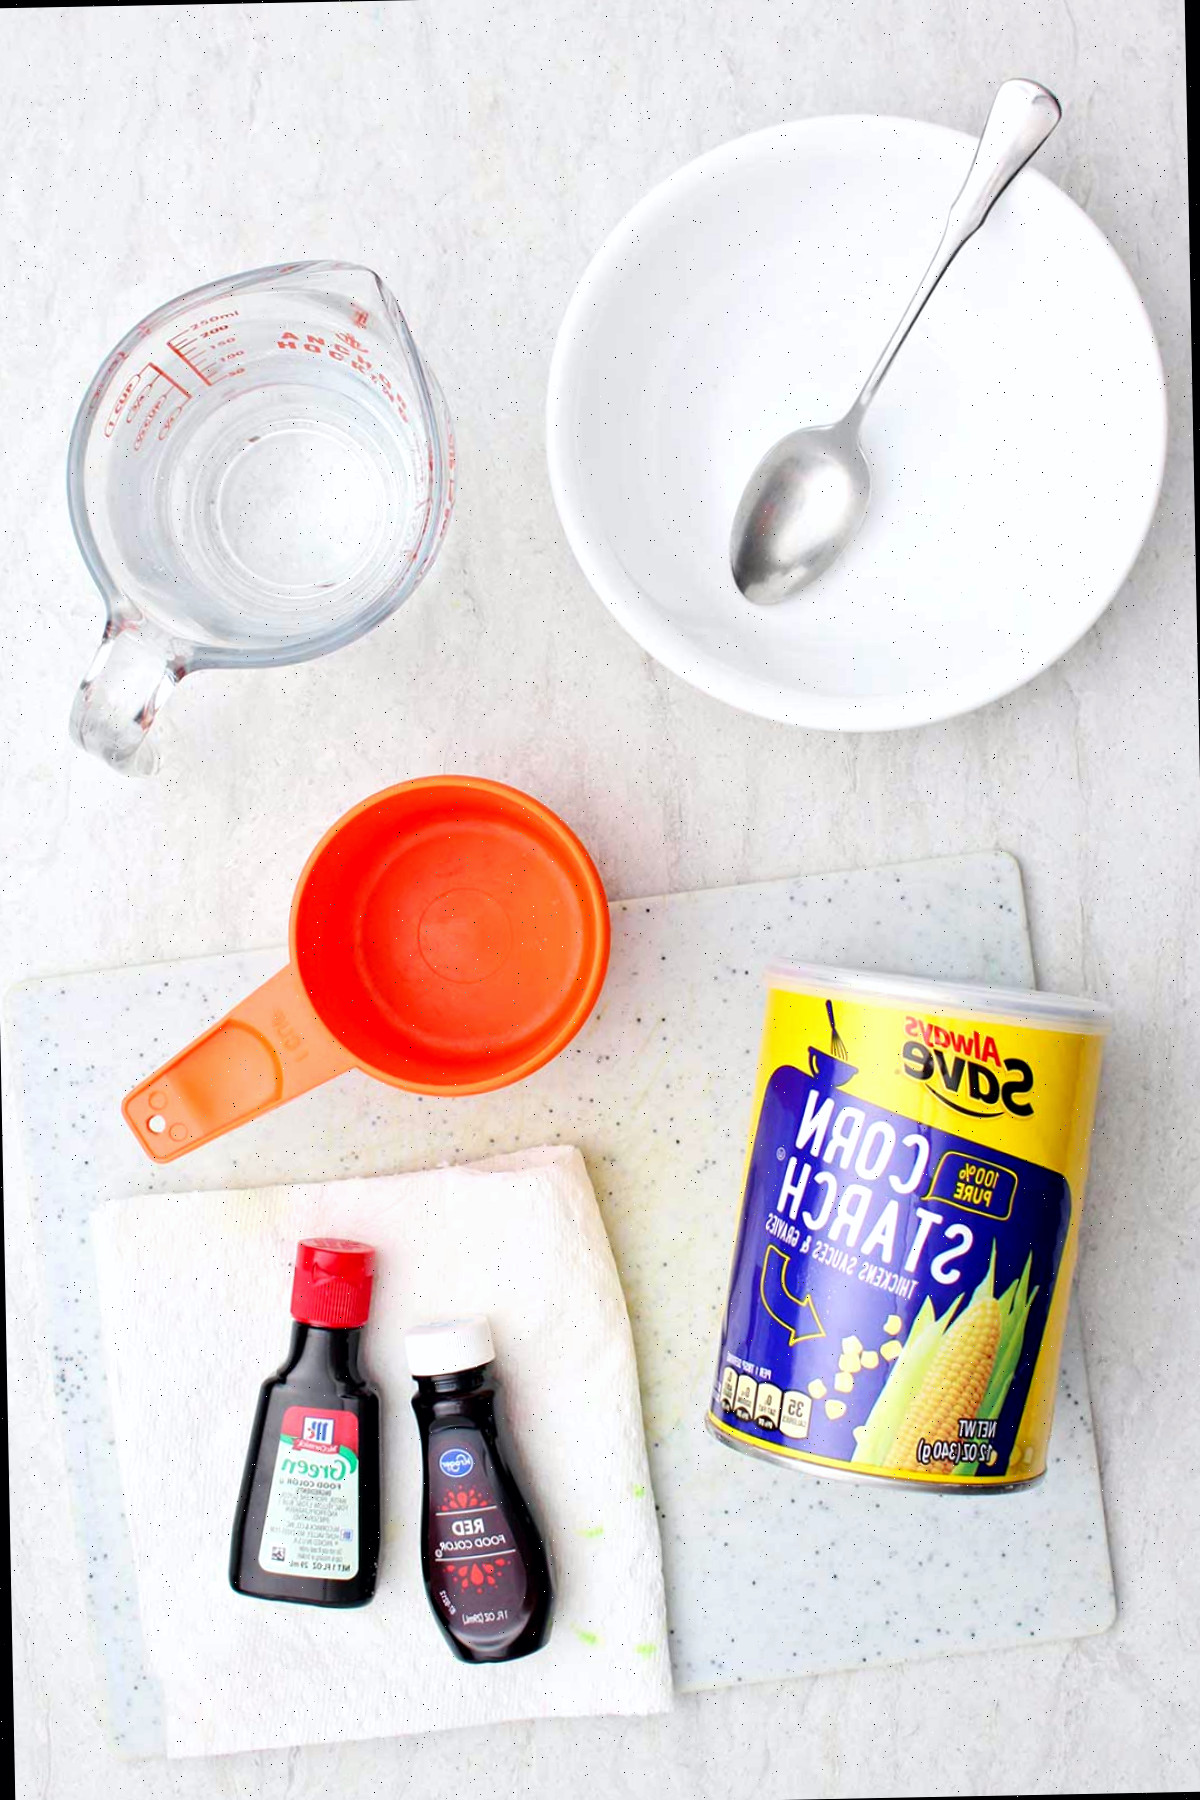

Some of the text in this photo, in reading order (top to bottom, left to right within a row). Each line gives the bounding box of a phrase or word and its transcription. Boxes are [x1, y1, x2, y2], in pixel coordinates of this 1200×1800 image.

[190, 310, 240, 331] 250ml
[200, 324, 230, 338] 200
[210, 336, 236, 350] 150
[220, 350, 246, 363] 100
[228, 367, 246, 377] 50
[115, 383, 133, 414] CUP
